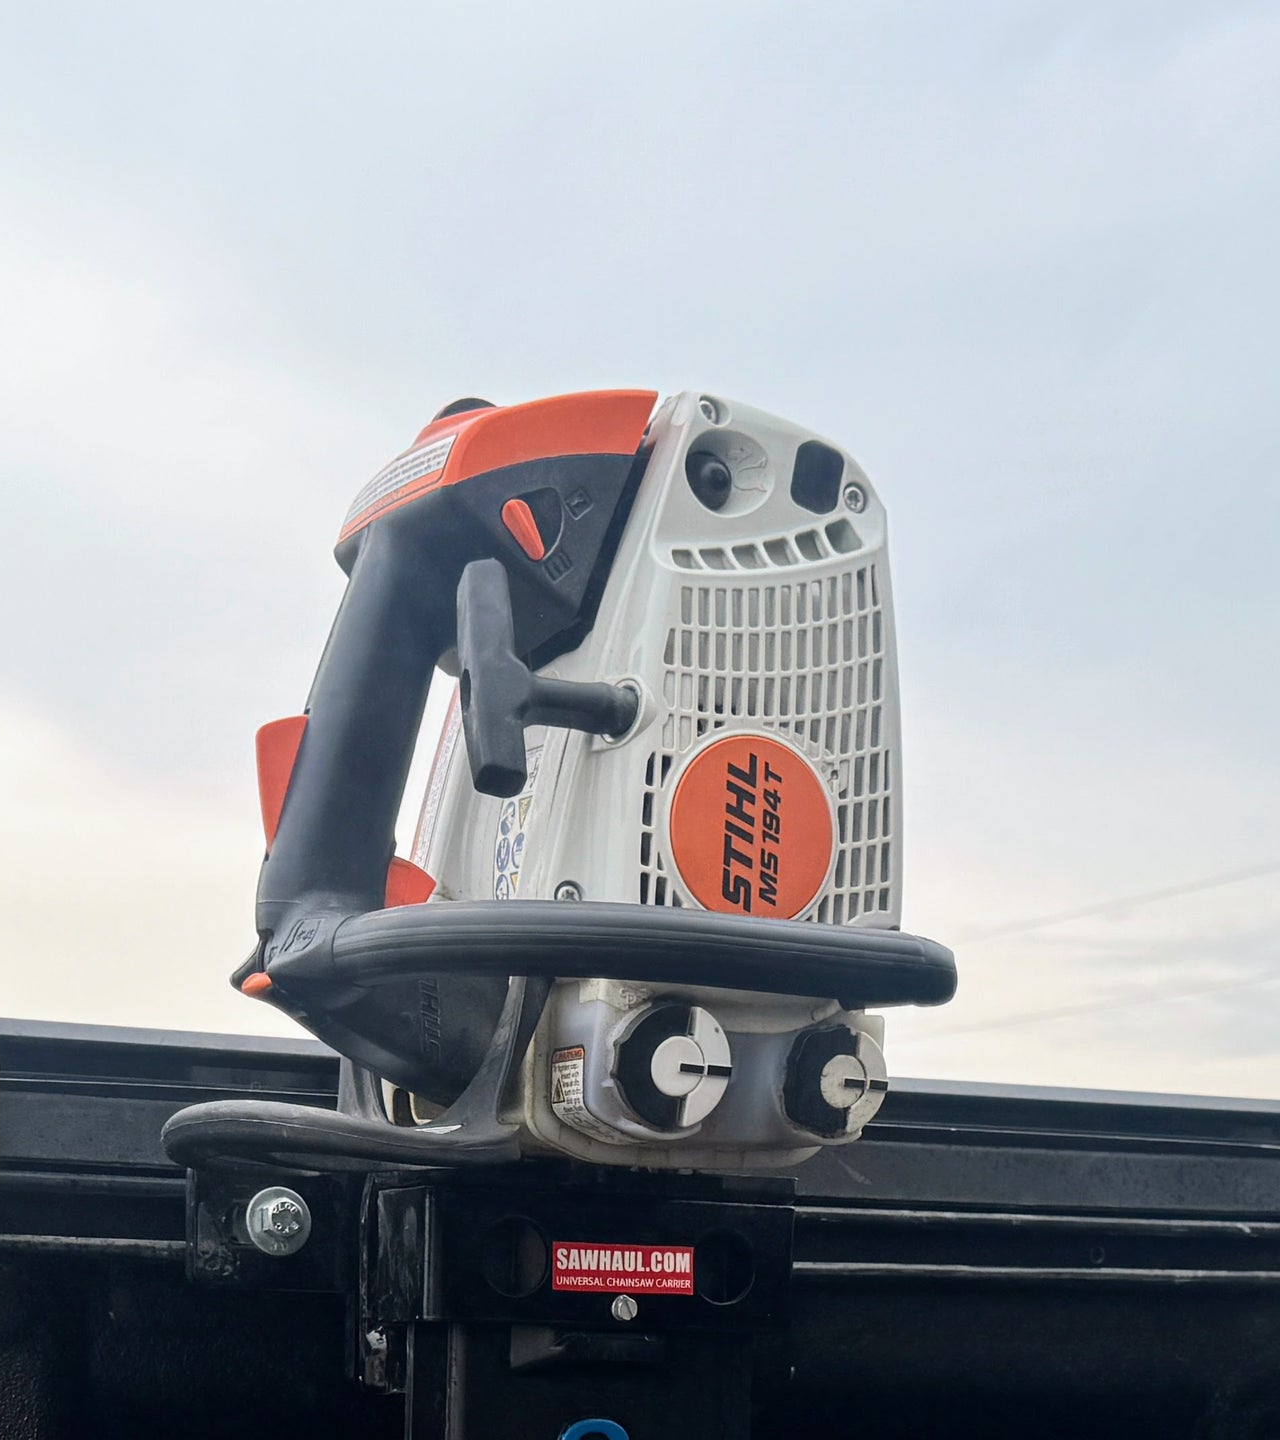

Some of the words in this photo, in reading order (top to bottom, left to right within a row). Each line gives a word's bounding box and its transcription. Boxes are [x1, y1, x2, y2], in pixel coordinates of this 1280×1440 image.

[722, 752, 757, 913] STIHL
[759, 848, 778, 907] MS
[556, 1248, 691, 1273] SAWHAUL.COM
[556, 1276, 604, 1287] UNIVERSAL
[606, 1277, 655, 1288] CHAINSAW
[655, 1278, 691, 1289] CARRIER
